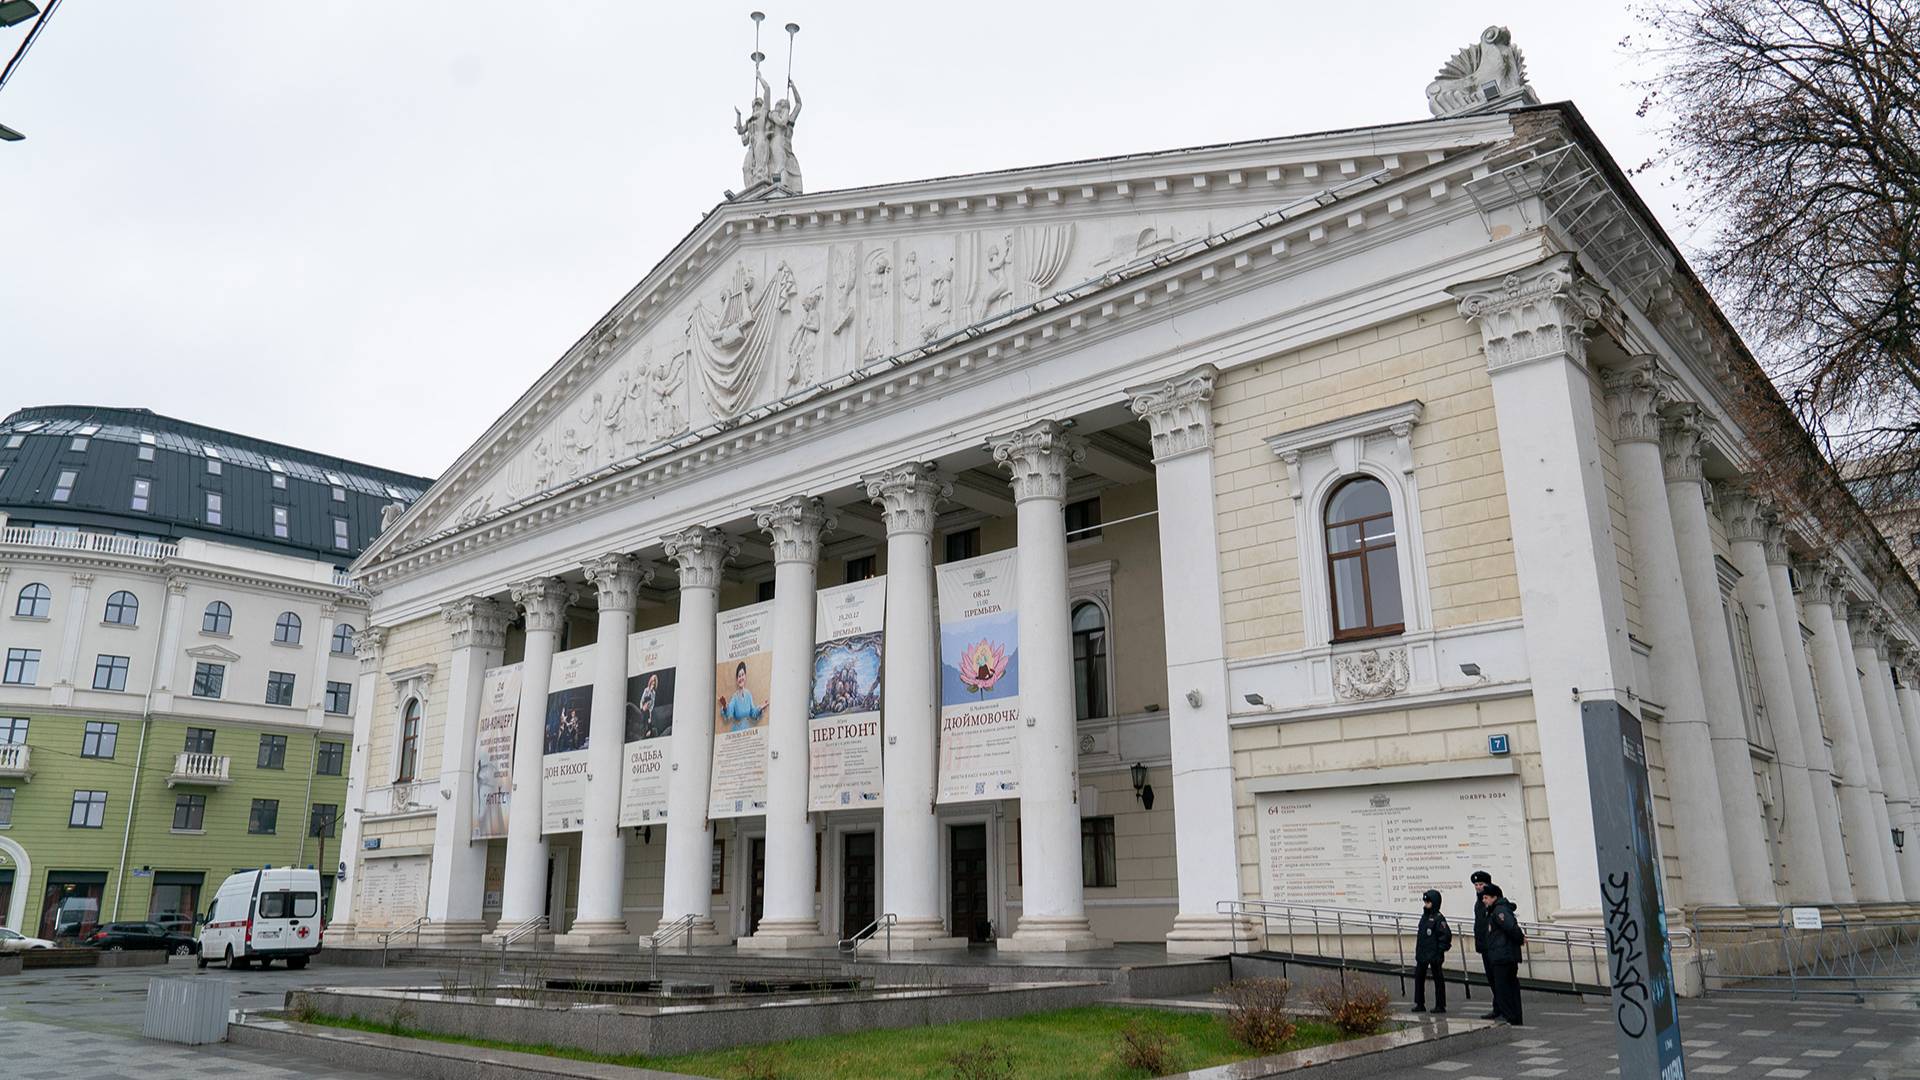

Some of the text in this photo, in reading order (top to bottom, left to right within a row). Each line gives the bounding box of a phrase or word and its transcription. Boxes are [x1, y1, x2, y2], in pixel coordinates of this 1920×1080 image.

[973, 589, 991, 599] 08.12
[964, 604, 1002, 618] ПРЕМЬЕРА
[813, 722, 877, 742] ПЕР ГЮНТ
[1494, 740, 1501, 748] 7
[631, 749, 663, 764] СВАДЬБА
[544, 762, 588, 780] ДОН КИХОТ
[631, 761, 661, 776] ФИГАРО
[1267, 806, 1279, 815] 64
